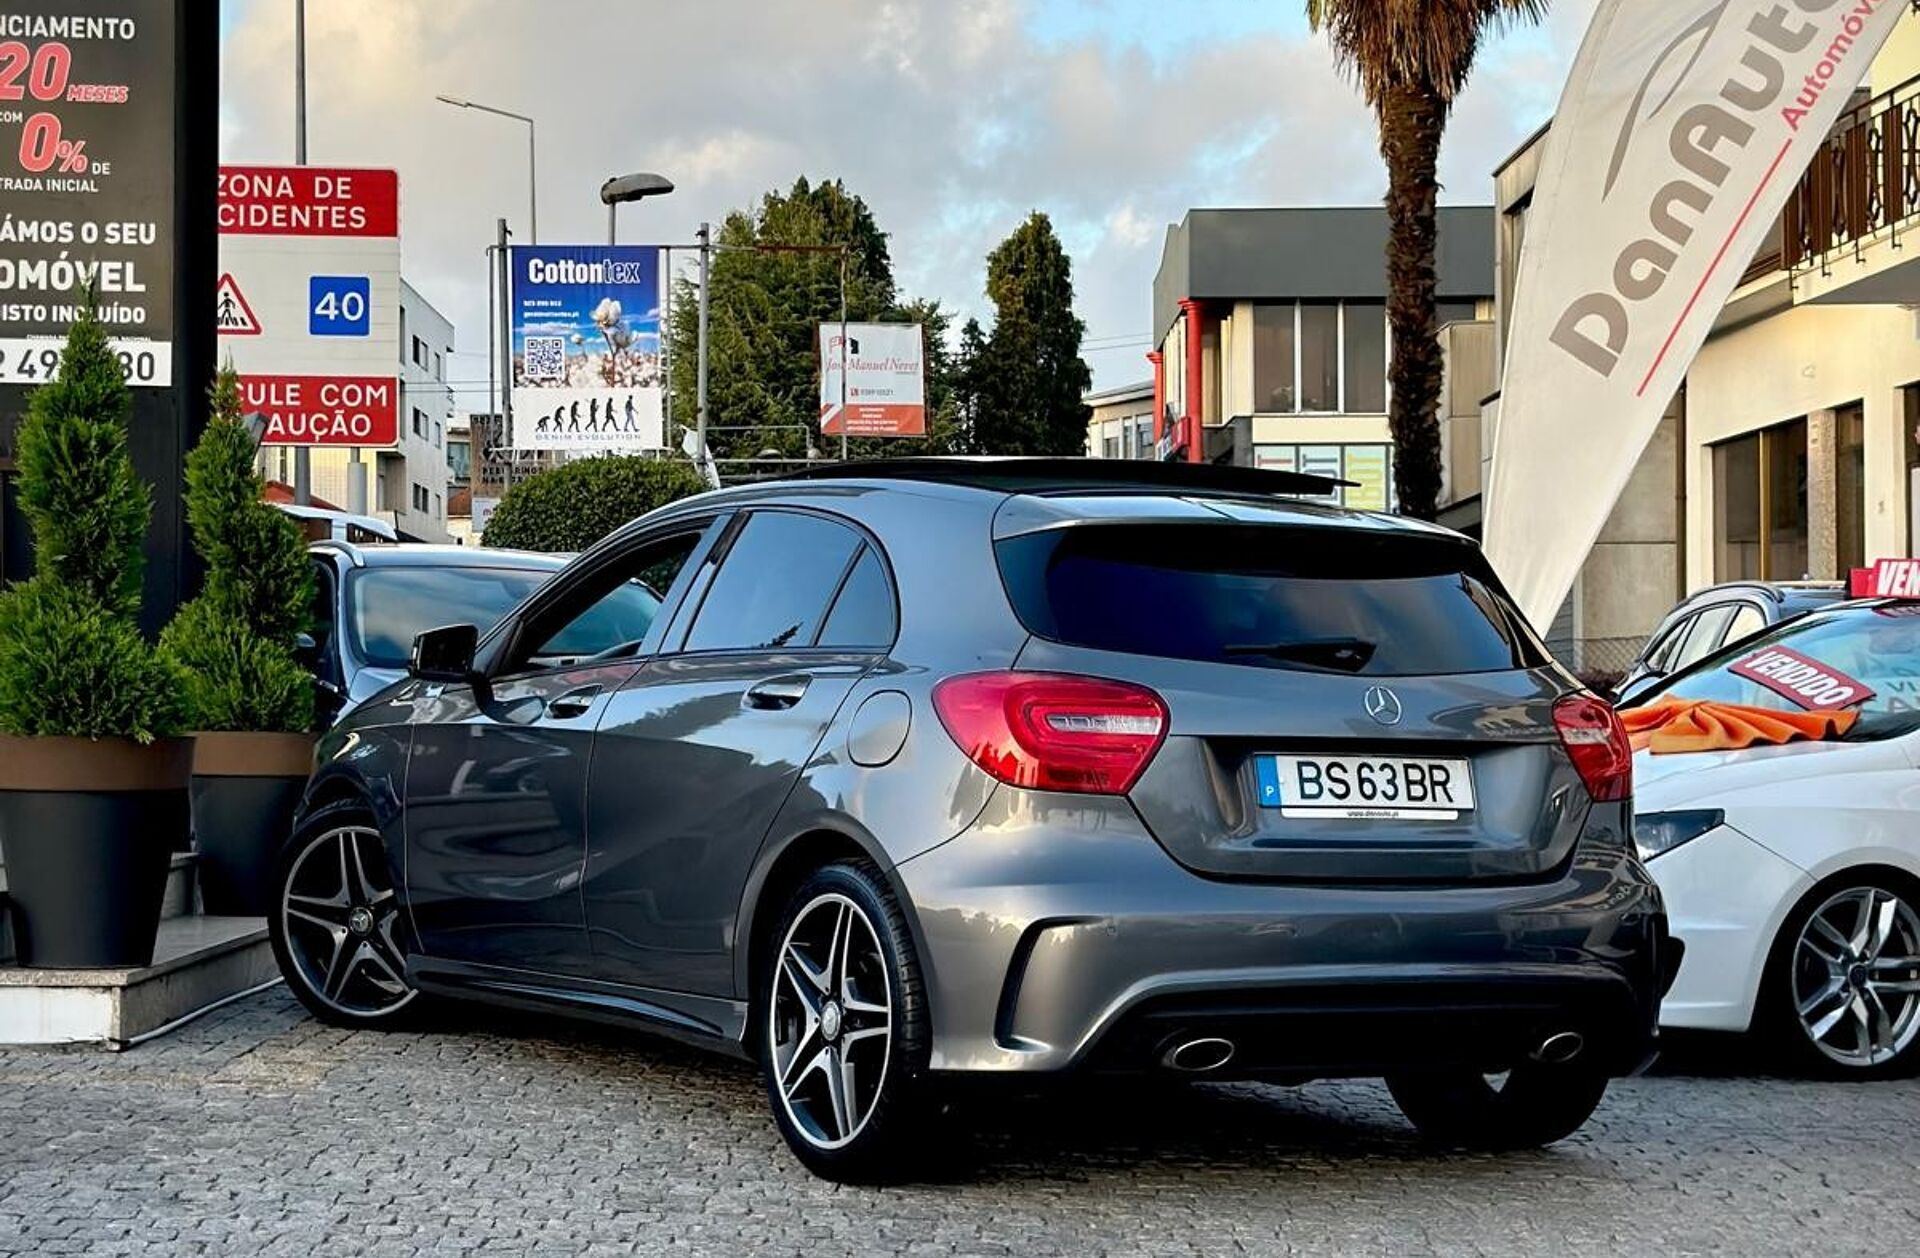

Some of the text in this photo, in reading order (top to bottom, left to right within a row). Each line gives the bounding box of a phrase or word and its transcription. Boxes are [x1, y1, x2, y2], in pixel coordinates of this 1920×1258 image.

[0, 41, 129, 104] 20 MESES
[1781, 0, 1884, 132] Automóv
[92, 162, 111, 175] DE
[46, 179, 99, 193] INICIAL
[314, 176, 352, 199] DE
[1549, 0, 1841, 378] DanAut
[81, 221, 98, 244] O
[104, 222, 156, 245] SEU
[0, 251, 146, 292] OMÓVEL
[528, 258, 641, 284] Cottontex
[314, 292, 364, 321] 40
[235, 382, 387, 408] ULE COM
[1745, 651, 1854, 706] VENDIDO
[1266, 785, 1275, 797] P
